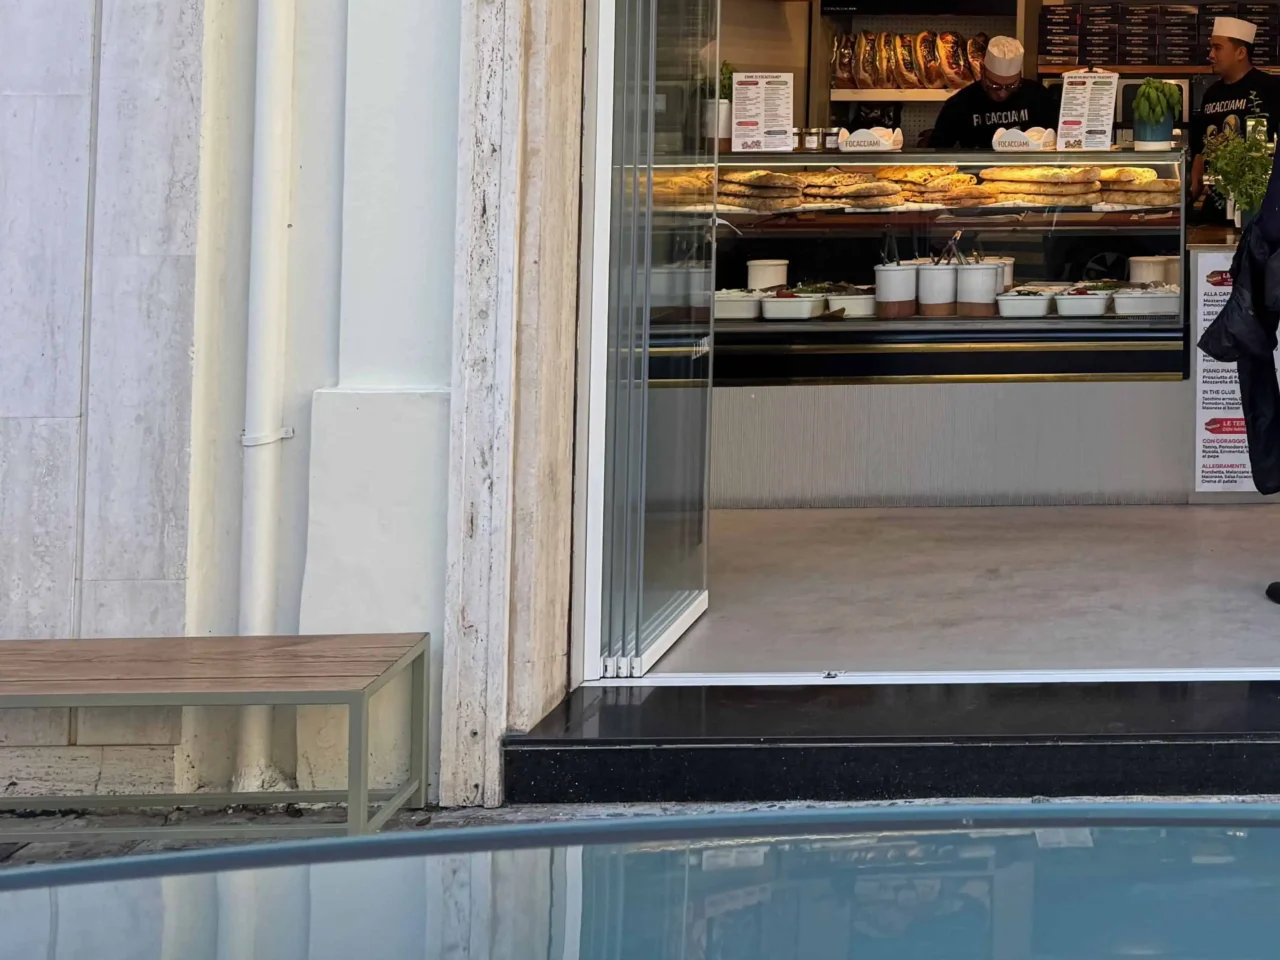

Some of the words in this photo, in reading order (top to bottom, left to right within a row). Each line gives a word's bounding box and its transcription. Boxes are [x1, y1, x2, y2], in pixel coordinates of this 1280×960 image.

[1204, 98, 1247, 114] FOCACCIAMI
[845, 140, 880, 148] FOCACCIAMI
[997, 140, 1029, 148] FOCACCIAMI
